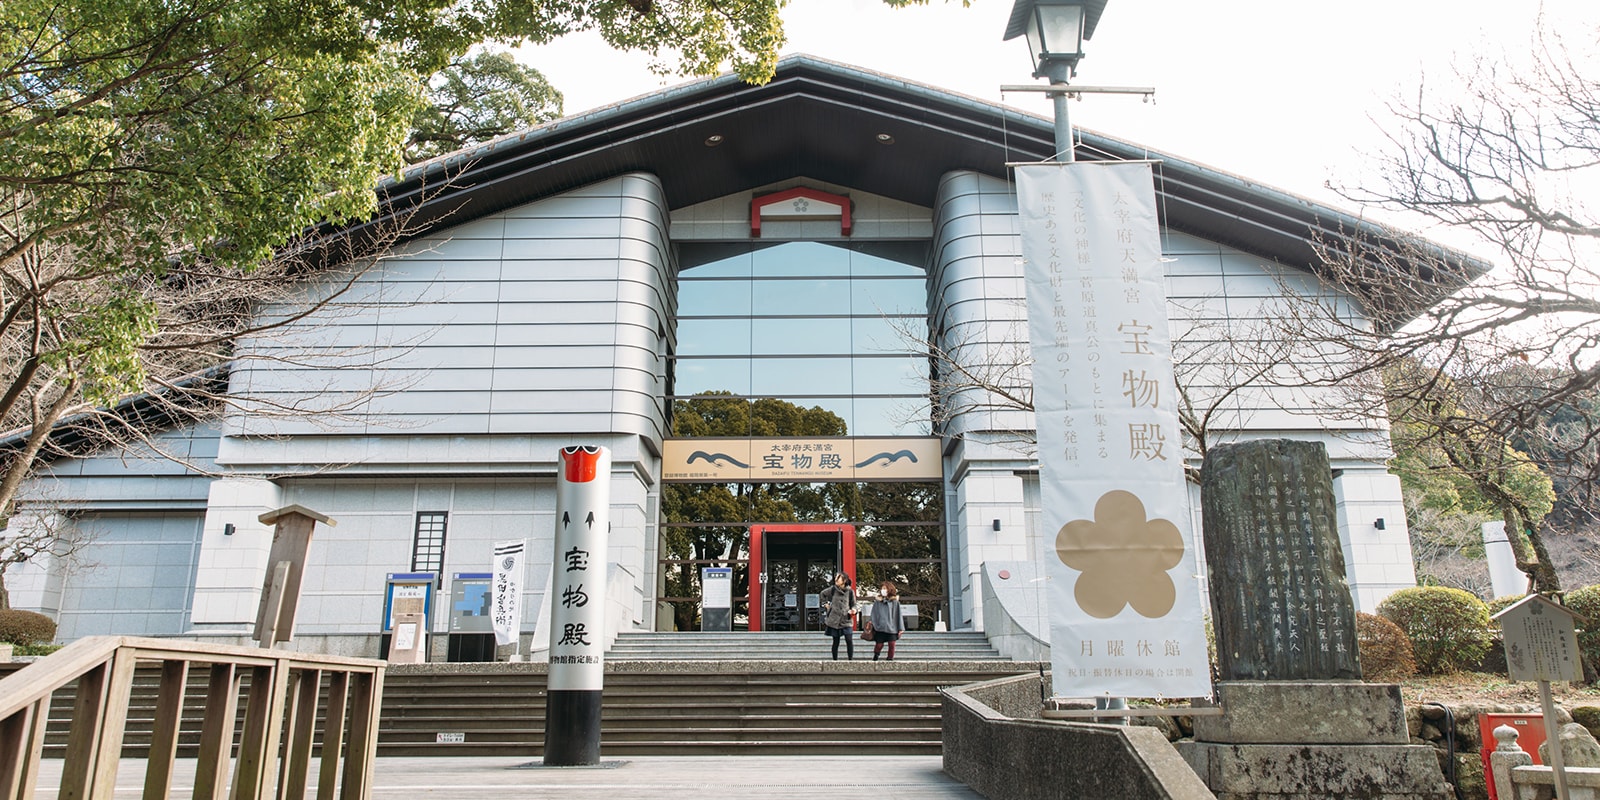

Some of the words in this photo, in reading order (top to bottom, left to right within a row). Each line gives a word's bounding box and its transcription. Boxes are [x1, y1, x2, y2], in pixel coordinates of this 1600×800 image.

[1112, 191, 1141, 305] 太宰府天満宮
[1041, 191, 1080, 468] 歴史ある文化財と最先端のアートを発信。
[1069, 189, 1108, 460] 「文化の神様」菅原道真公のもとに集まる
[1117, 319, 1168, 462] 宝物殿
[762, 454, 841, 469] 宝物殿
[771, 443, 833, 452] 太宰府天満宮
[558, 546, 591, 646] 宝物殿
[1081, 639, 1181, 657] 月曜休館
